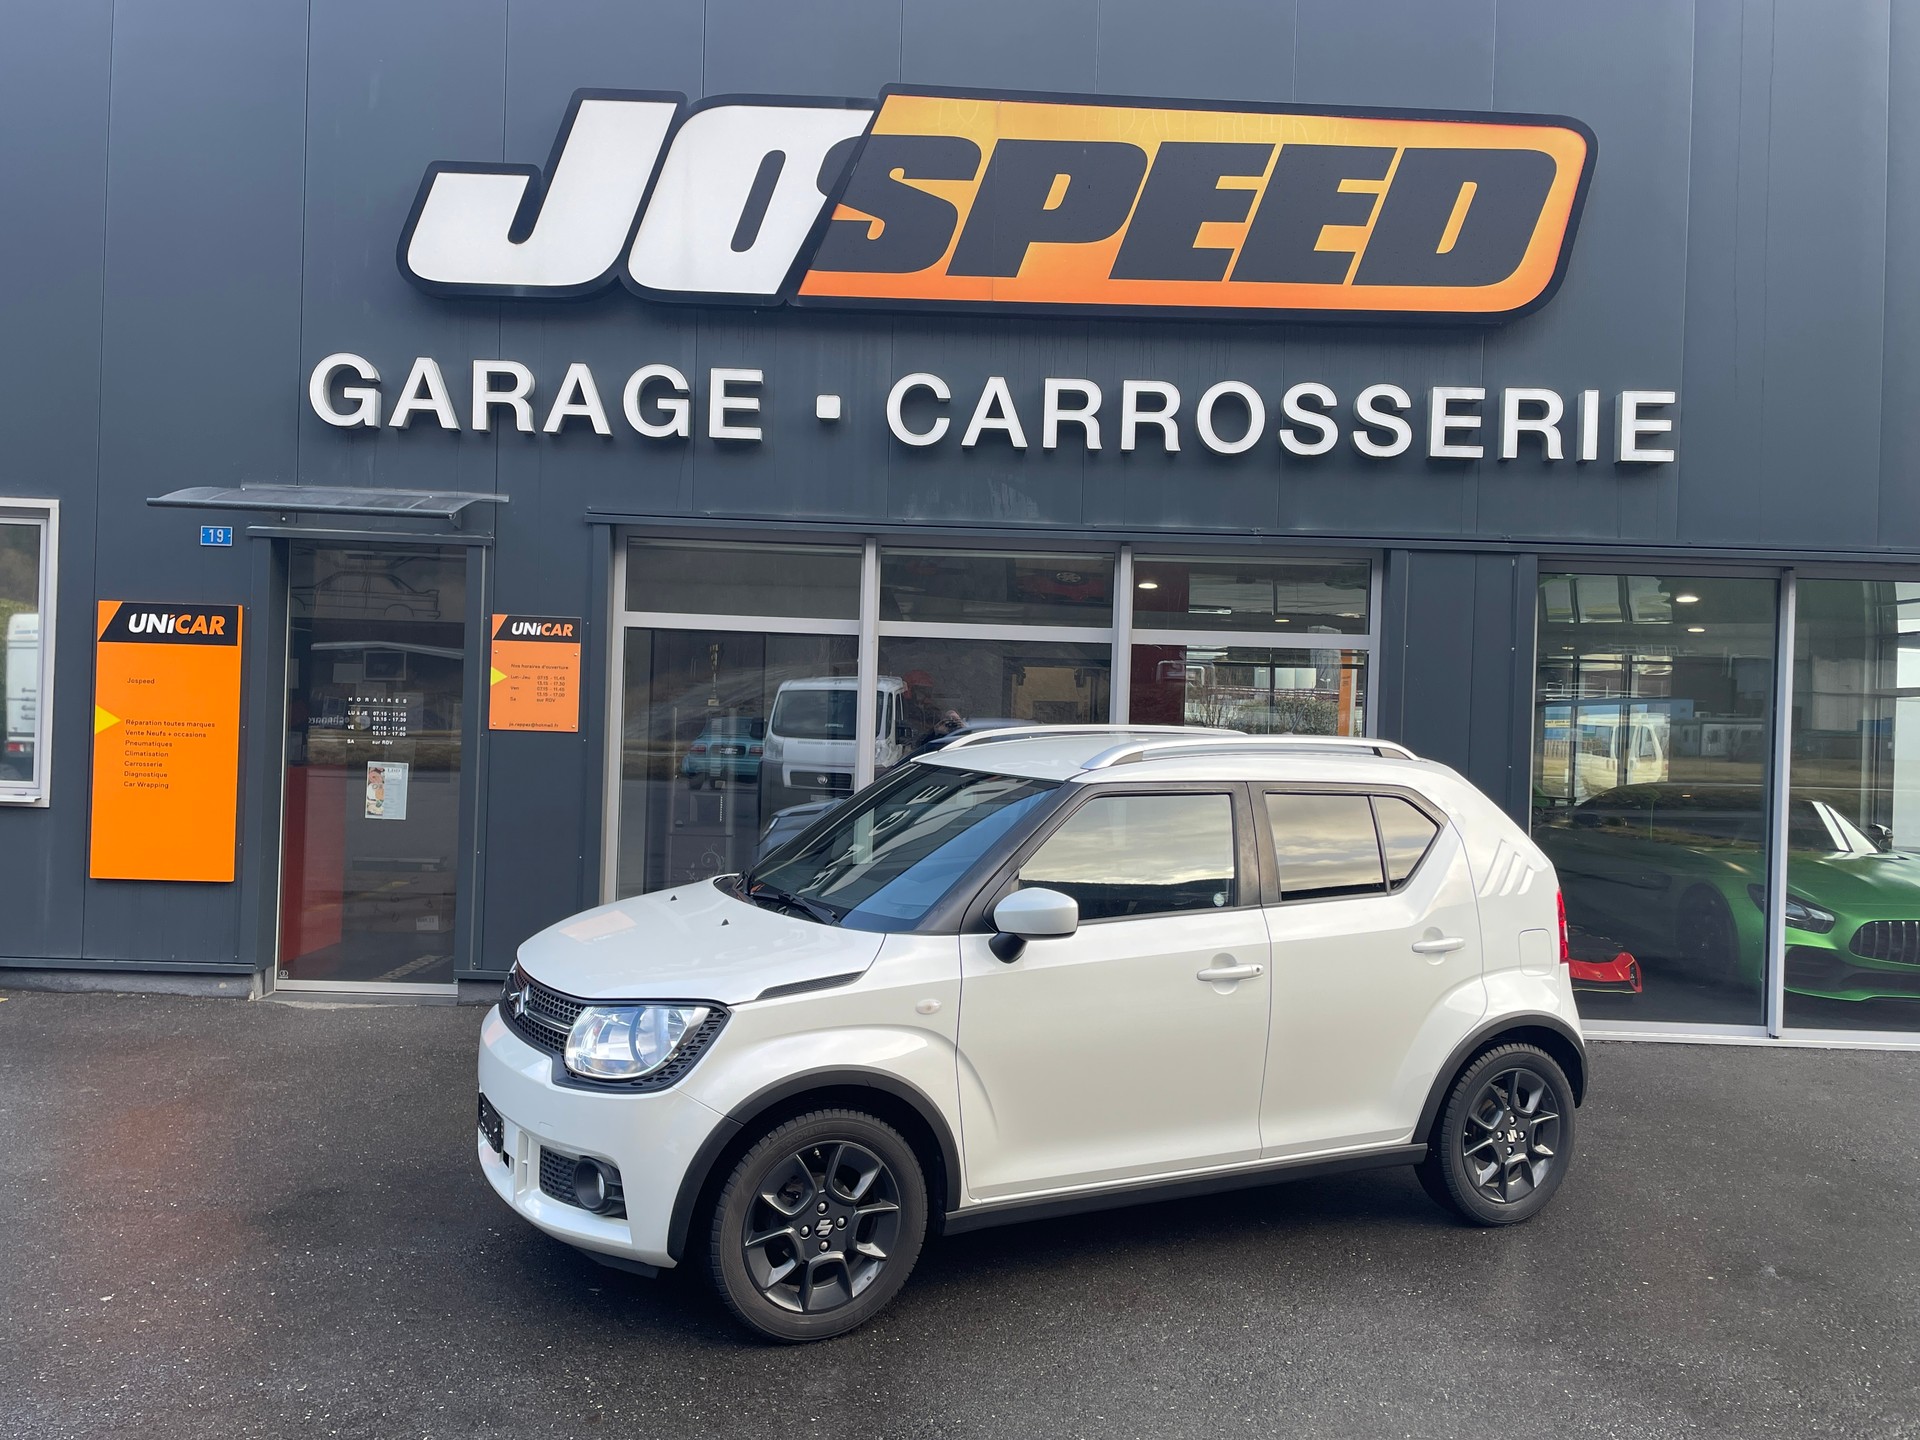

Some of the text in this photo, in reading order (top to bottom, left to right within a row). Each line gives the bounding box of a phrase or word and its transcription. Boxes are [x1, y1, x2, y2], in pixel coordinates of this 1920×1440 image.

[309, 352, 1676, 464] GARAGE CARROSSERIE
[208, 529, 224, 543] 19
[127, 678, 155, 686] Jospeed
[126, 719, 162, 727] Réparation
